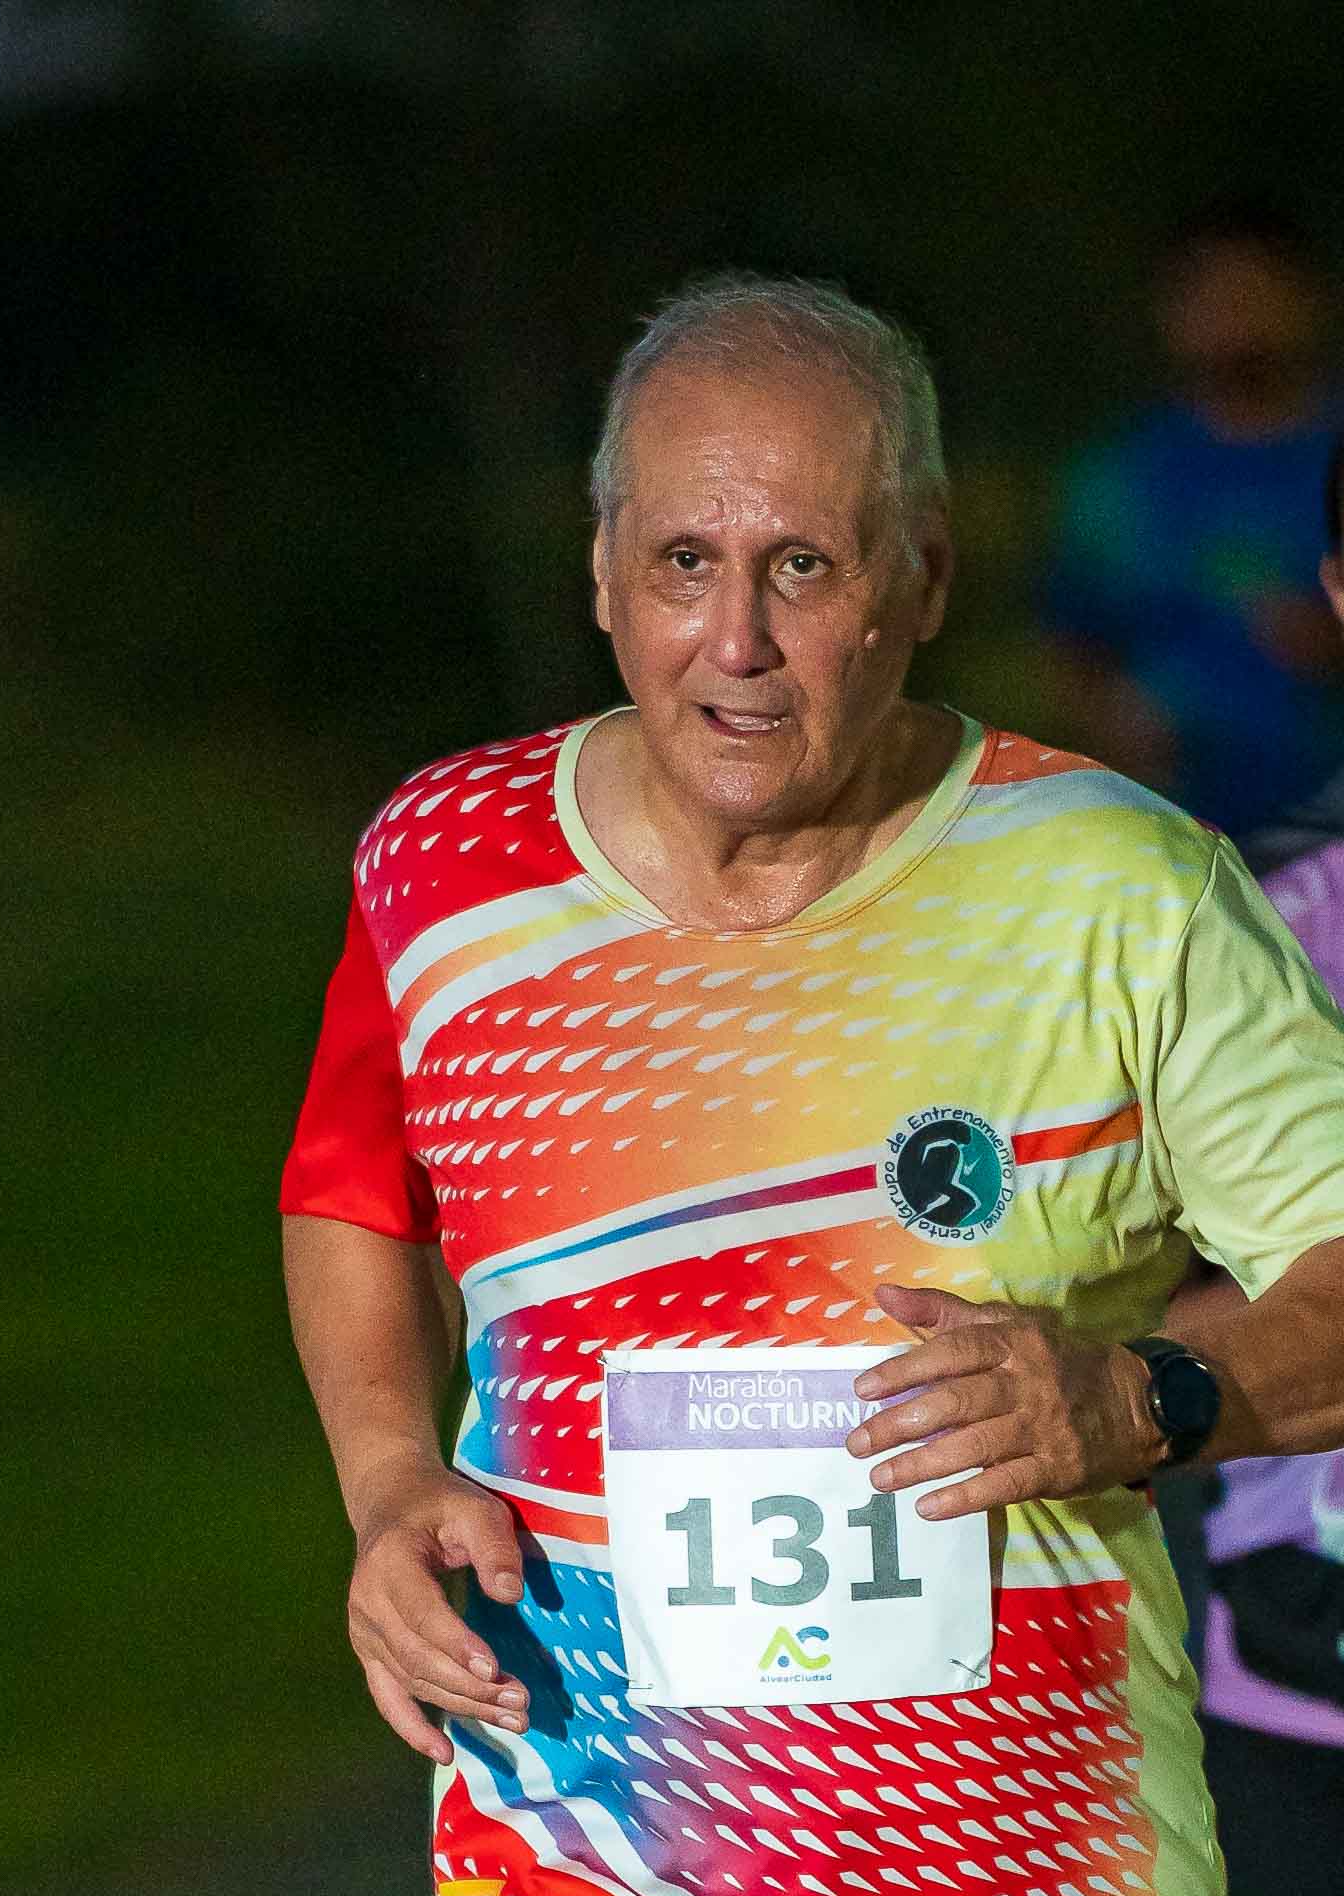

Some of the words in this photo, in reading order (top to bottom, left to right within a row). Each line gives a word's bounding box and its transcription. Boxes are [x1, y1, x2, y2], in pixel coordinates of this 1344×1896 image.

[886, 1132, 907, 1154] de
[907, 1106, 1015, 1180] Entrenamiento
[884, 1161, 914, 1219] Grupo
[980, 1187, 1014, 1236] Daniel
[917, 1219, 975, 1241] Penta
[688, 1370, 804, 1398] Maratón
[665, 1493, 923, 1606] 131
[758, 1626, 832, 1671] AC
